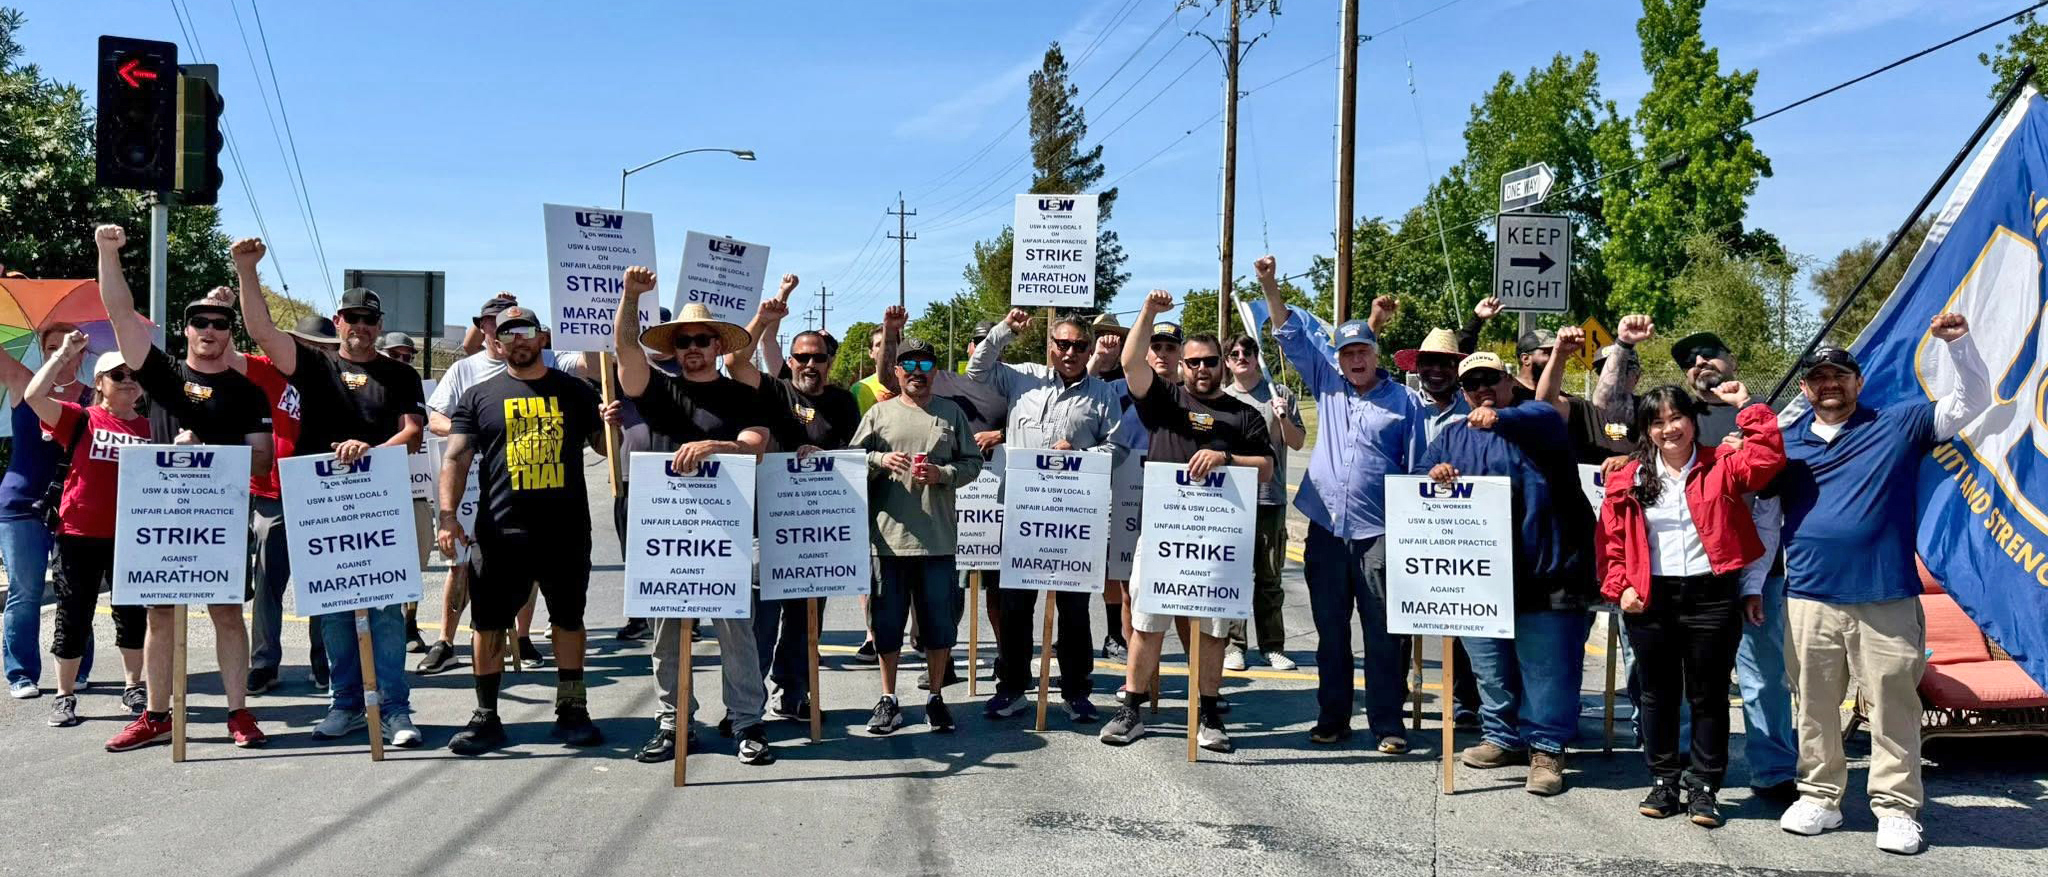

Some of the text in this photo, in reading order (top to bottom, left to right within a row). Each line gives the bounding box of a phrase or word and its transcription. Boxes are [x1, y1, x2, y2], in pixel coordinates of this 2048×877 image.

[1506, 177, 1538, 199] ONE WAY
[1039, 200, 1074, 211] USW
[575, 212, 623, 229] USW
[1508, 227, 1560, 245] KEEP
[709, 239, 746, 257] USW
[1026, 249, 1082, 261] STRIKE
[728, 268, 745, 276] LOCAL
[1021, 273, 1086, 282] MARATHON
[727, 283, 753, 292] PRACTICE
[1018, 284, 1088, 294] PETROLEUM
[1503, 280, 1561, 298] RIGHT
[688, 289, 746, 311] STRIKE
[504, 396, 563, 418] FULL
[92, 444, 119, 458] HE
[156, 452, 215, 467] USW
[315, 456, 372, 477] USW
[787, 457, 835, 473] USW
[1036, 455, 1082, 471] USW
[508, 463, 564, 490] THAI
[307, 497, 325, 505] USW
[335, 494, 353, 502] USW
[355, 491, 379, 499] LOCAL
[1419, 483, 1474, 498] USW
[1960, 473, 1991, 514] AND
[299, 509, 400, 527] UNFAIR LABOR PRACTICE
[956, 510, 1004, 523] TRIKE
[136, 528, 226, 545] STRIKE
[775, 526, 851, 544] STRIKE
[1019, 522, 1091, 540] STRIKE
[1208, 526, 1243, 534] PRACTICE
[308, 529, 396, 556] STRIKE
[646, 539, 732, 557] STRIKE
[1158, 542, 1236, 561] STRIKE
[336, 560, 372, 570] AGAINST
[772, 565, 856, 580] MARATHON
[1012, 558, 1092, 572] MARATHON
[1180, 569, 1211, 577] AGAINST
[1405, 558, 1491, 576] STRIKE
[128, 570, 228, 583] MARATHON
[309, 569, 407, 594] MARATHON
[639, 582, 736, 596] MARATHON
[783, 586, 814, 594] MARTINEZ
[1153, 582, 1239, 599] MARATHON
[322, 593, 394, 609] MARTINEZ REFINERY
[1401, 601, 1498, 617] MARATHON
[1450, 624, 1484, 632] REFINERY
